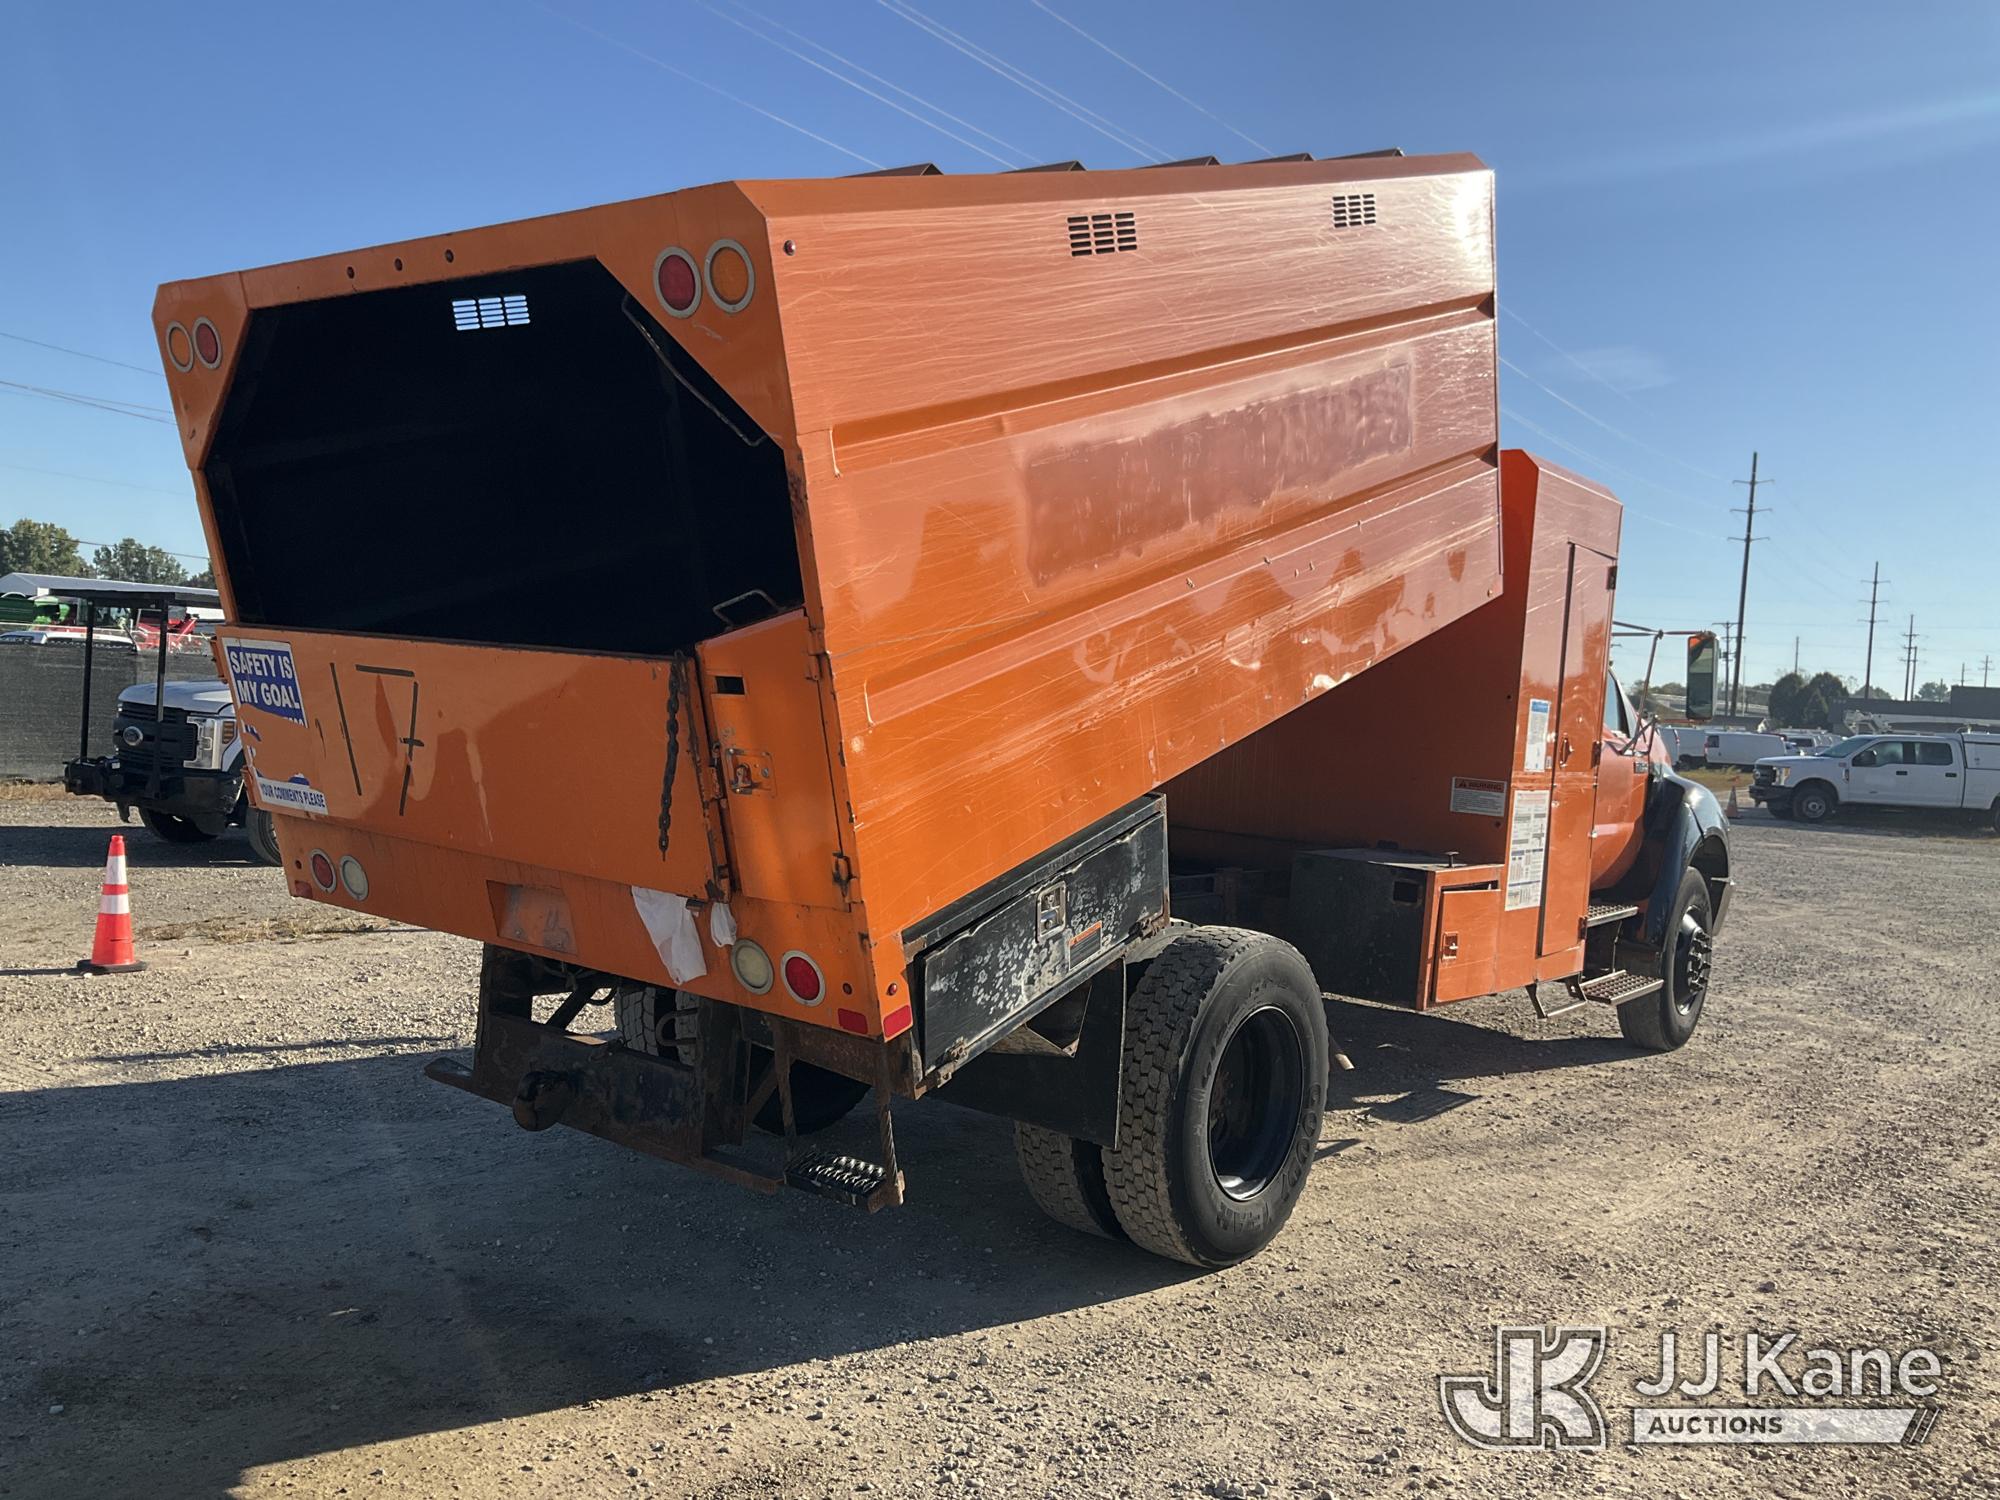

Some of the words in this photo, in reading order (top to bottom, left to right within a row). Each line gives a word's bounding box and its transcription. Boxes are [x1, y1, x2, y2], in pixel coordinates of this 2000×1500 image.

[229, 651, 276, 677] SAFETY
[278, 655, 293, 679] IS
[236, 680, 258, 704] MY
[260, 682, 300, 709] GOAL
[274, 786, 304, 804] COMMENTS
[303, 790, 326, 808] PLEASE
